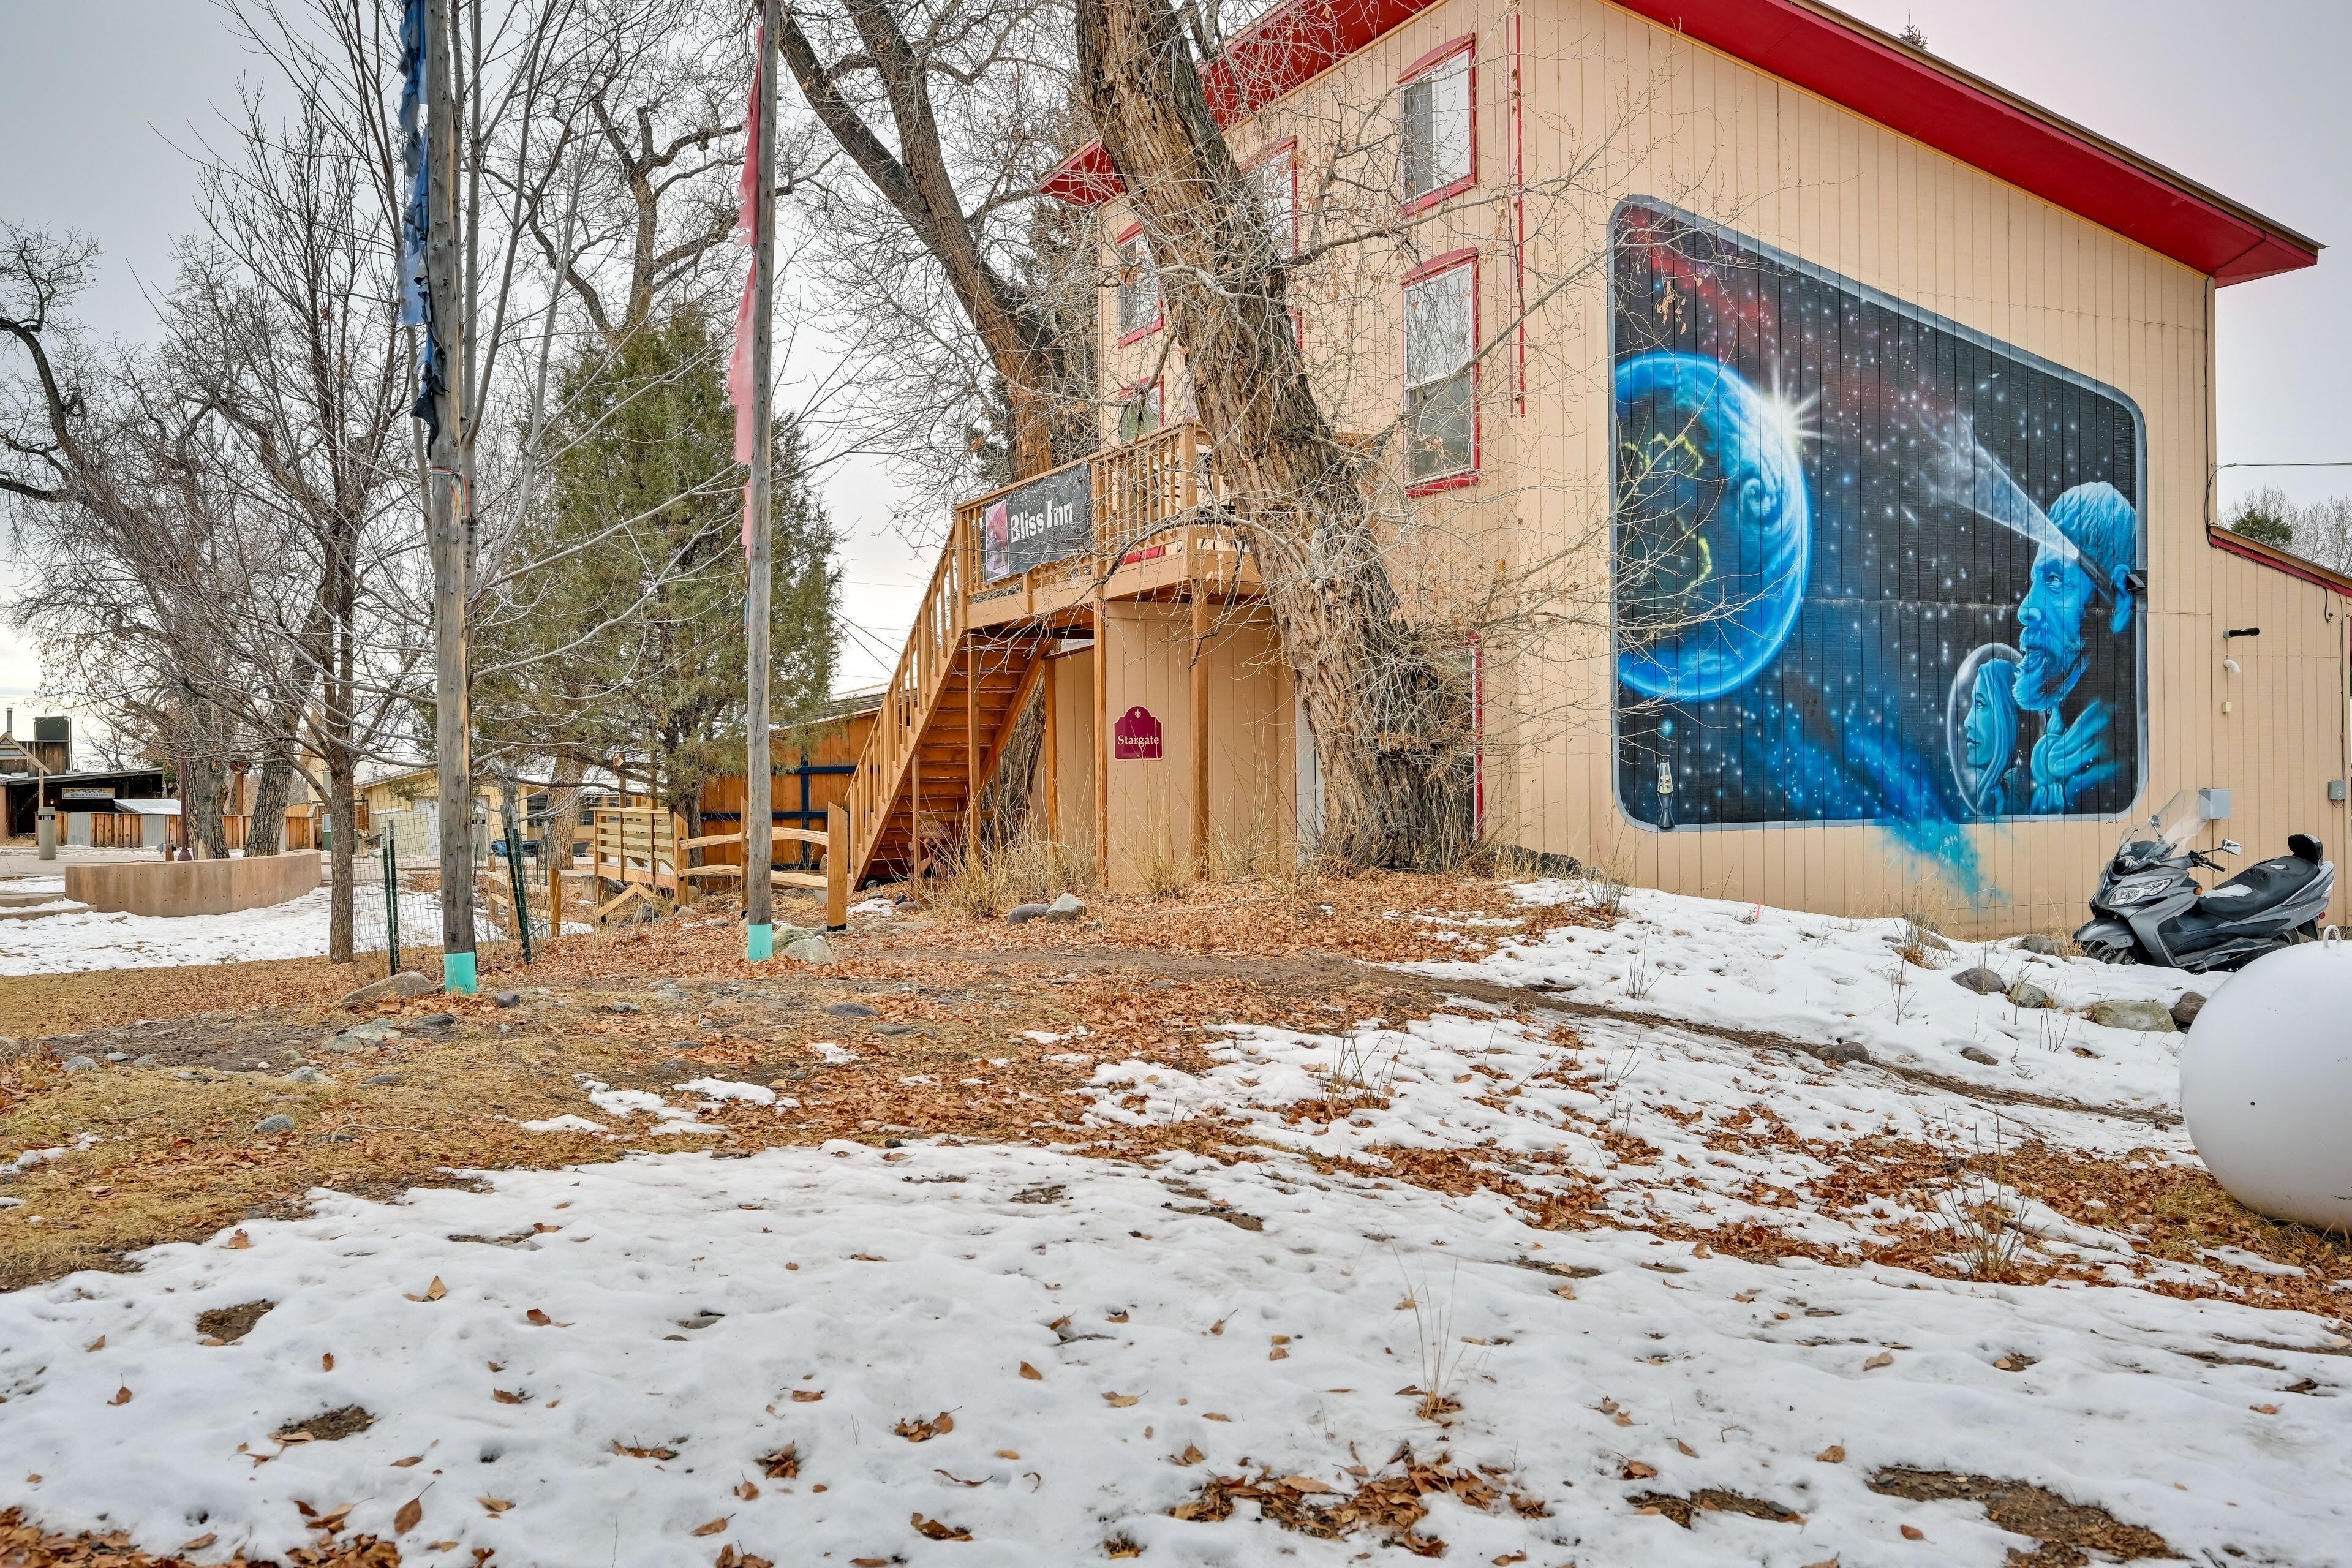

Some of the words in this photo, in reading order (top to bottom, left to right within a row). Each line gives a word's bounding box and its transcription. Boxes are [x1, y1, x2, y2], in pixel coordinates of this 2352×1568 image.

[1010, 511, 1044, 543] Bliss
[1047, 500, 1073, 528] Inn
[1118, 735, 1159, 747] Stargate
